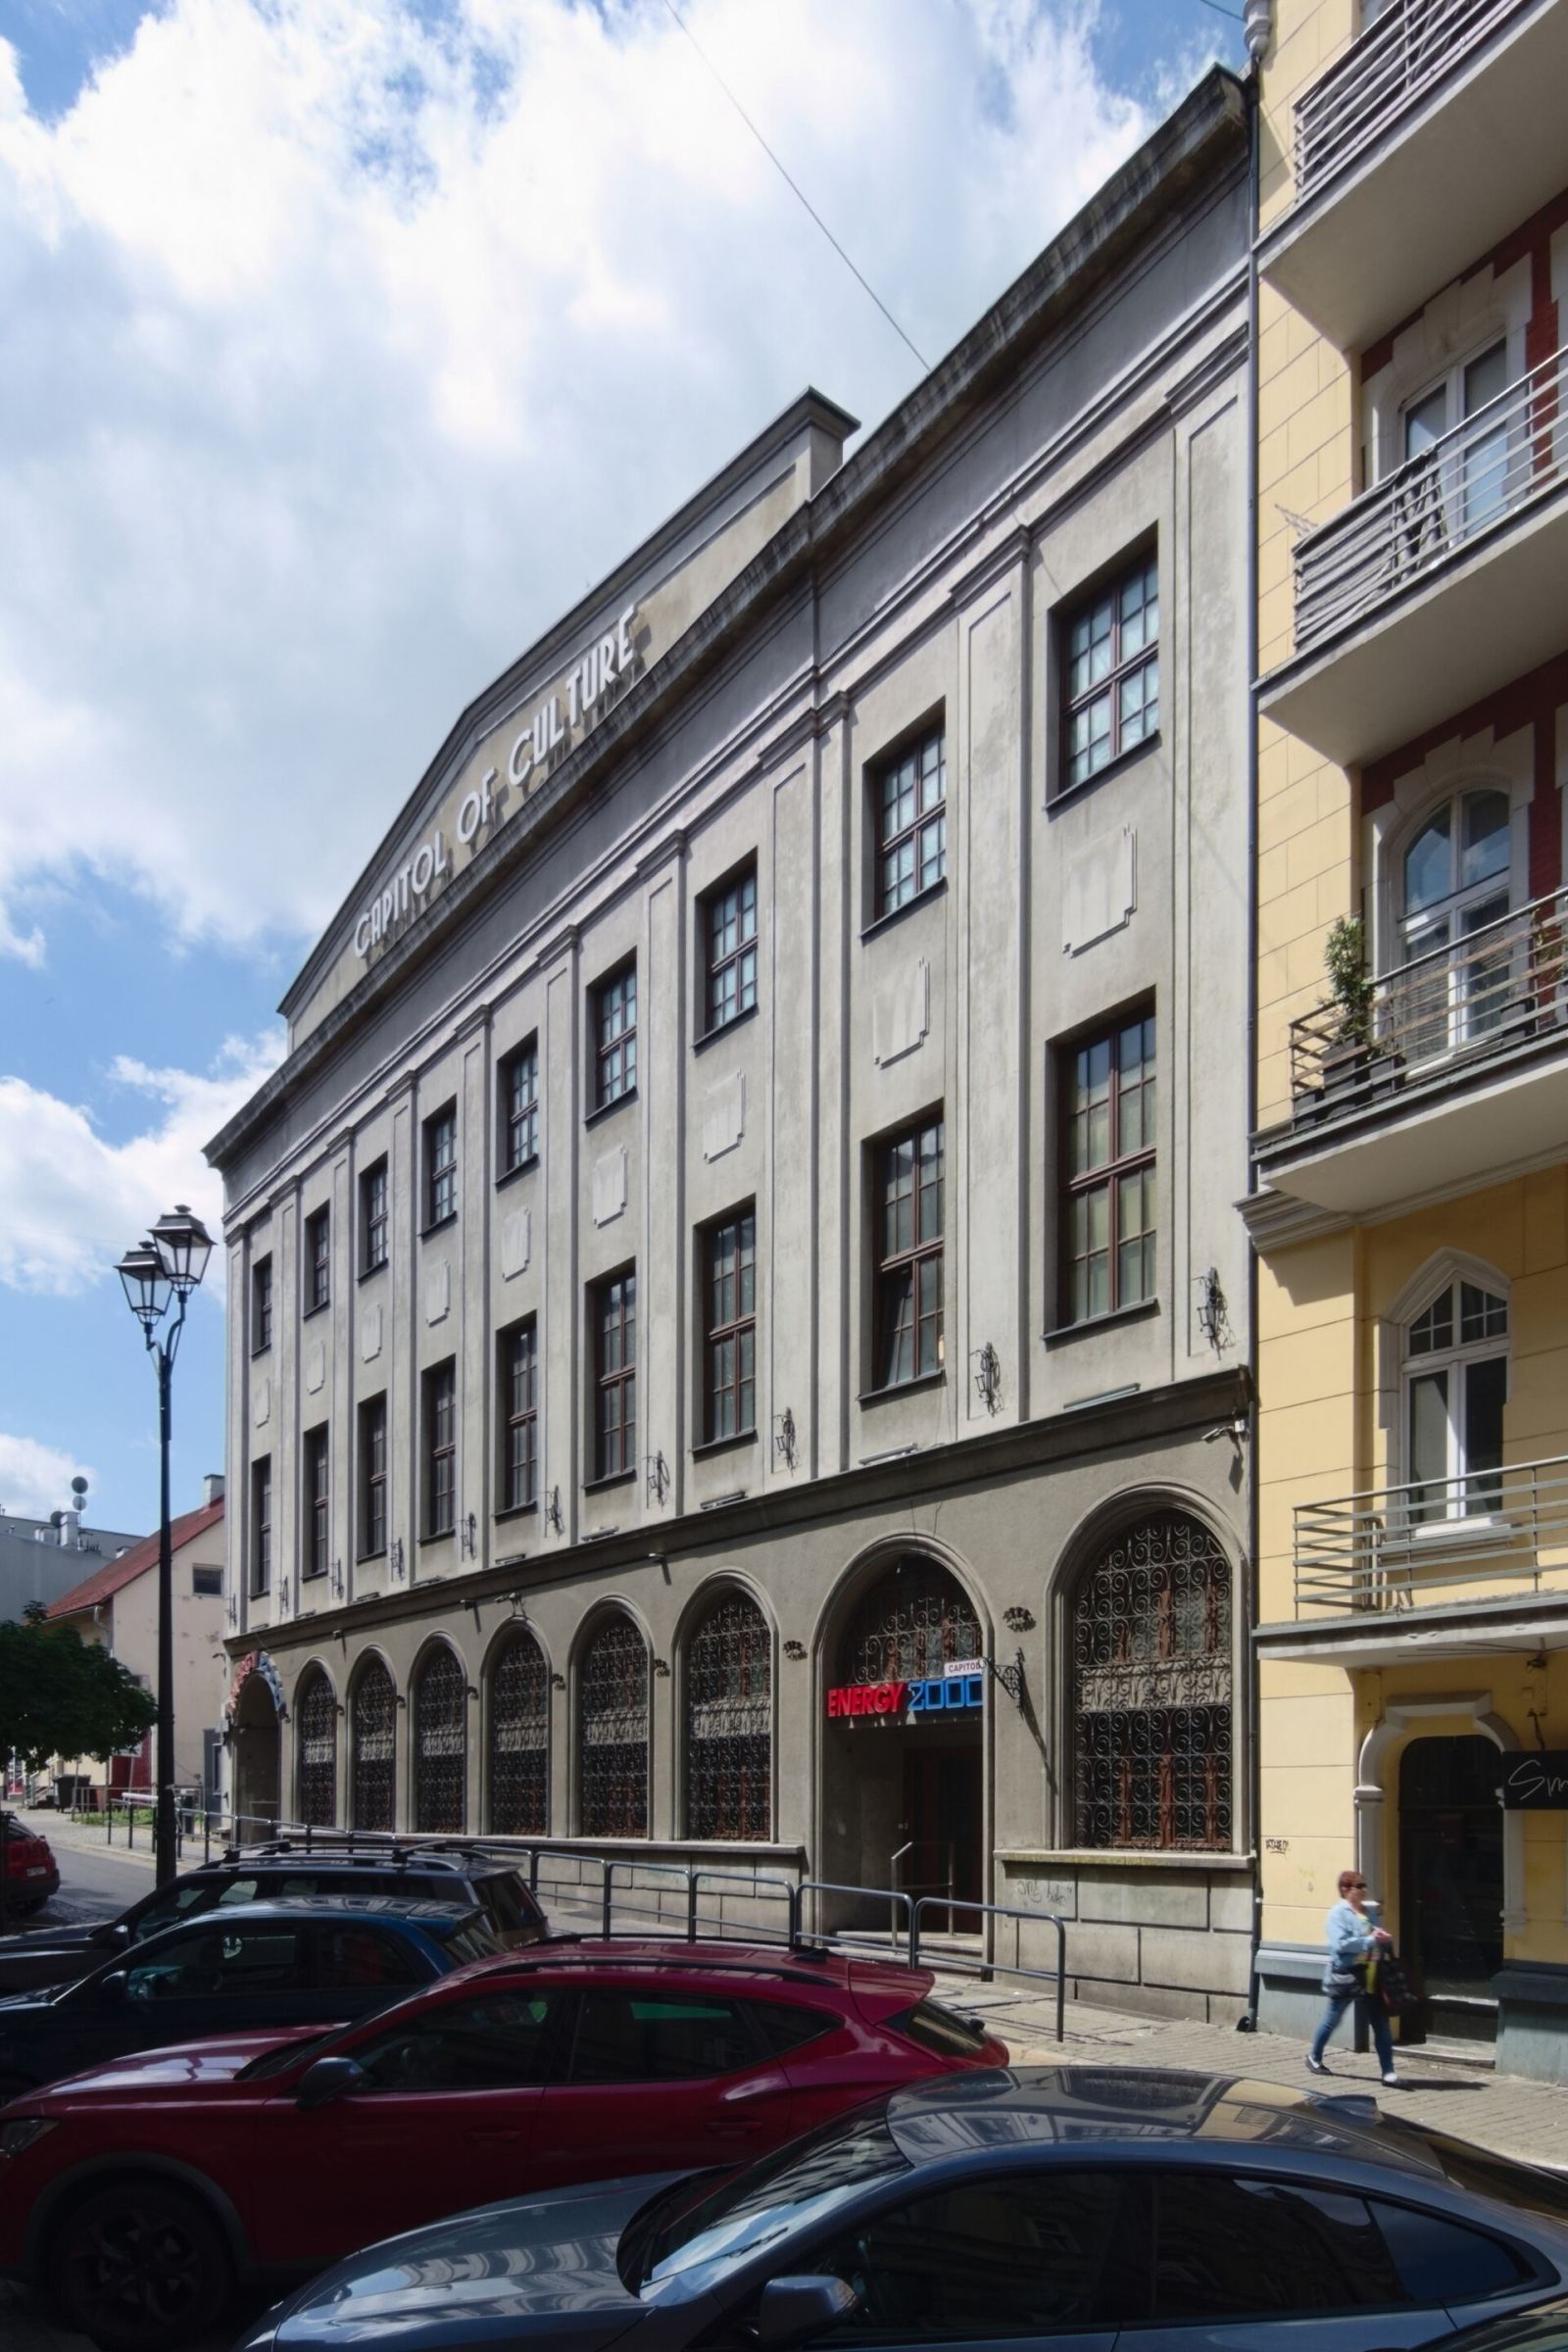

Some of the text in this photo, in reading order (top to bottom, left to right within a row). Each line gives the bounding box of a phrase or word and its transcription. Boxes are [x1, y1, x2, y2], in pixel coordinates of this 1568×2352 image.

[354, 604, 636, 957] CAPITOL OF CULTURE
[828, 1676, 983, 1717] ENERGY 2000
